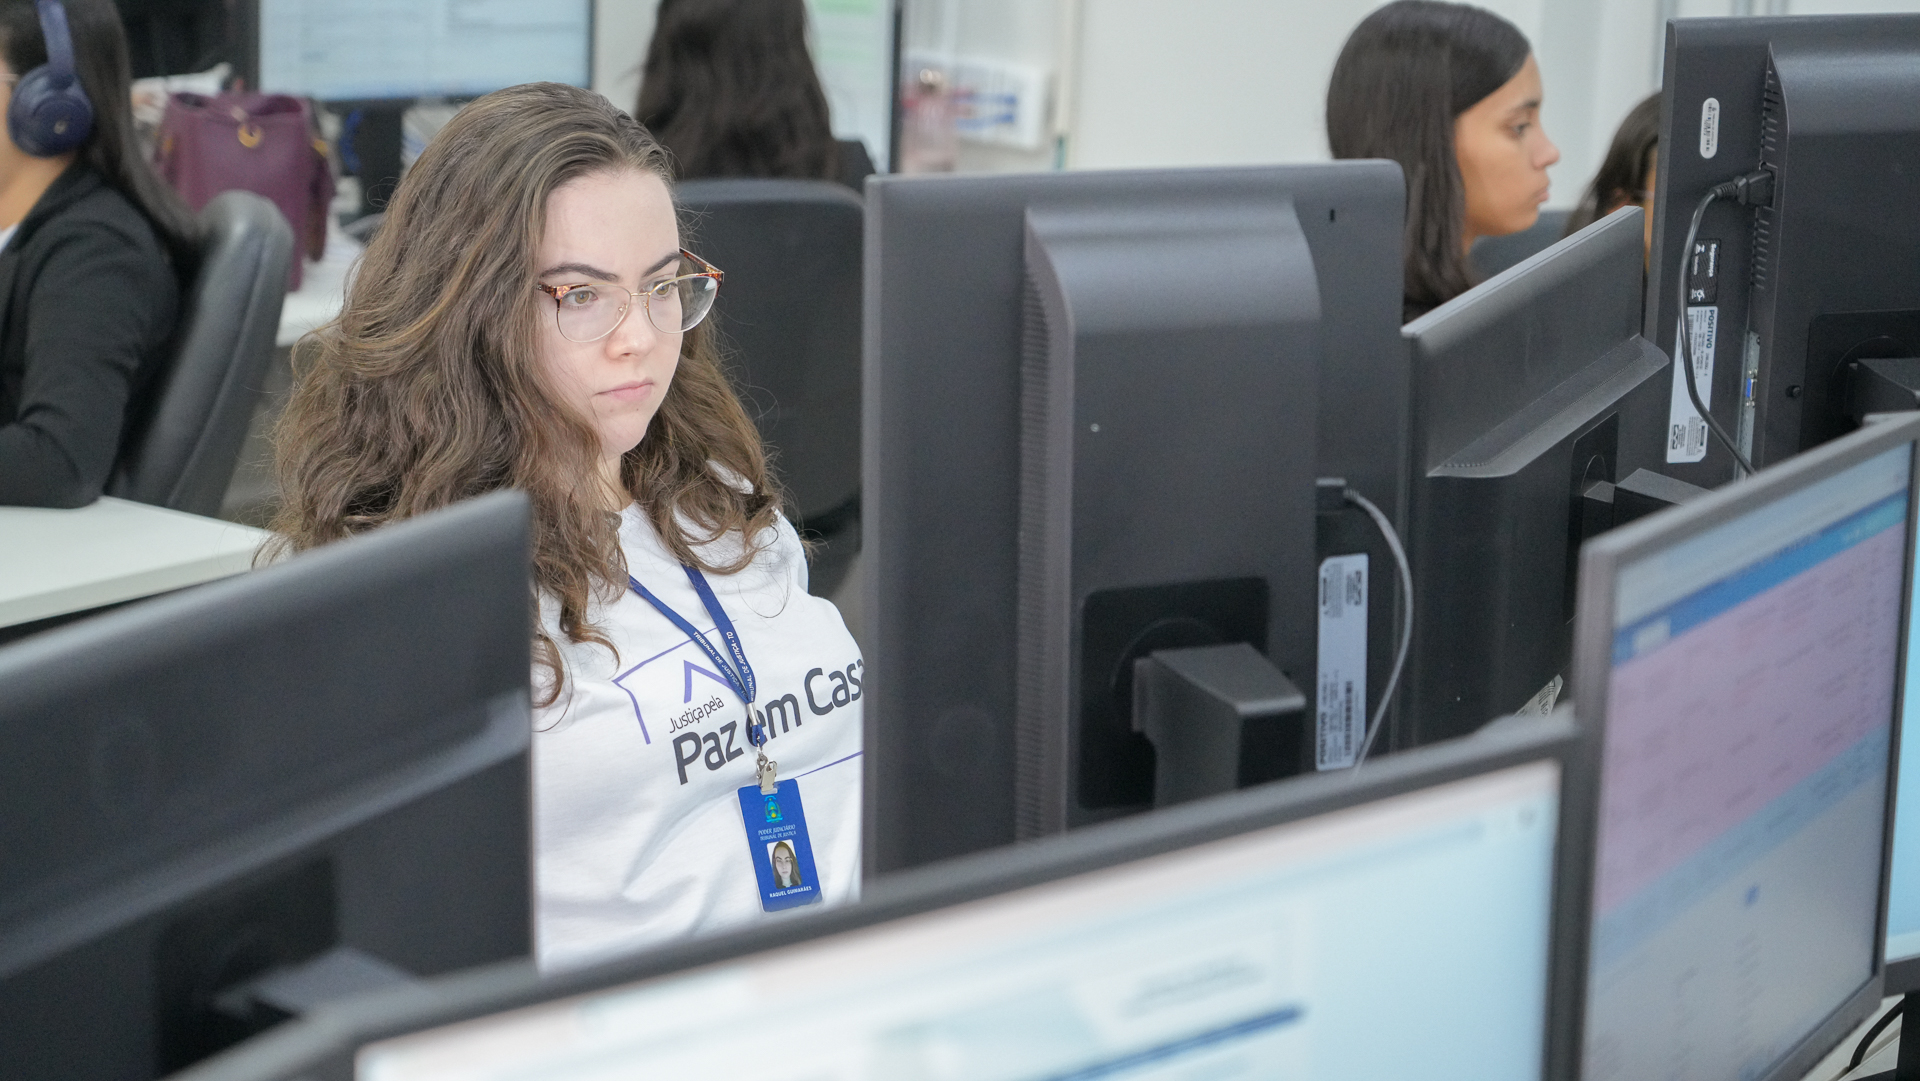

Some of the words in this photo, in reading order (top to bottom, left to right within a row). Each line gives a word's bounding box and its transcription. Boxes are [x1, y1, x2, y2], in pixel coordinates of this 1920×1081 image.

[1706, 309, 1715, 349] POSITIVO
[726, 631, 734, 640] TO
[693, 631, 716, 657] TRIBUNAL
[715, 655, 723, 665] DE
[721, 664, 740, 687] JUSTIÇA
[731, 642, 746, 665] JUSTIÇA
[742, 665, 750, 674] DE
[669, 707, 705, 733] Justiça
[703, 695, 725, 718] pela
[672, 720, 744, 785] Paz
[746, 693, 802, 747] em
[773, 824, 796, 834] JUDICIÁRIO
[783, 830, 797, 838] JUSTIÇA
[787, 886, 812, 894] GUIMARÃES
